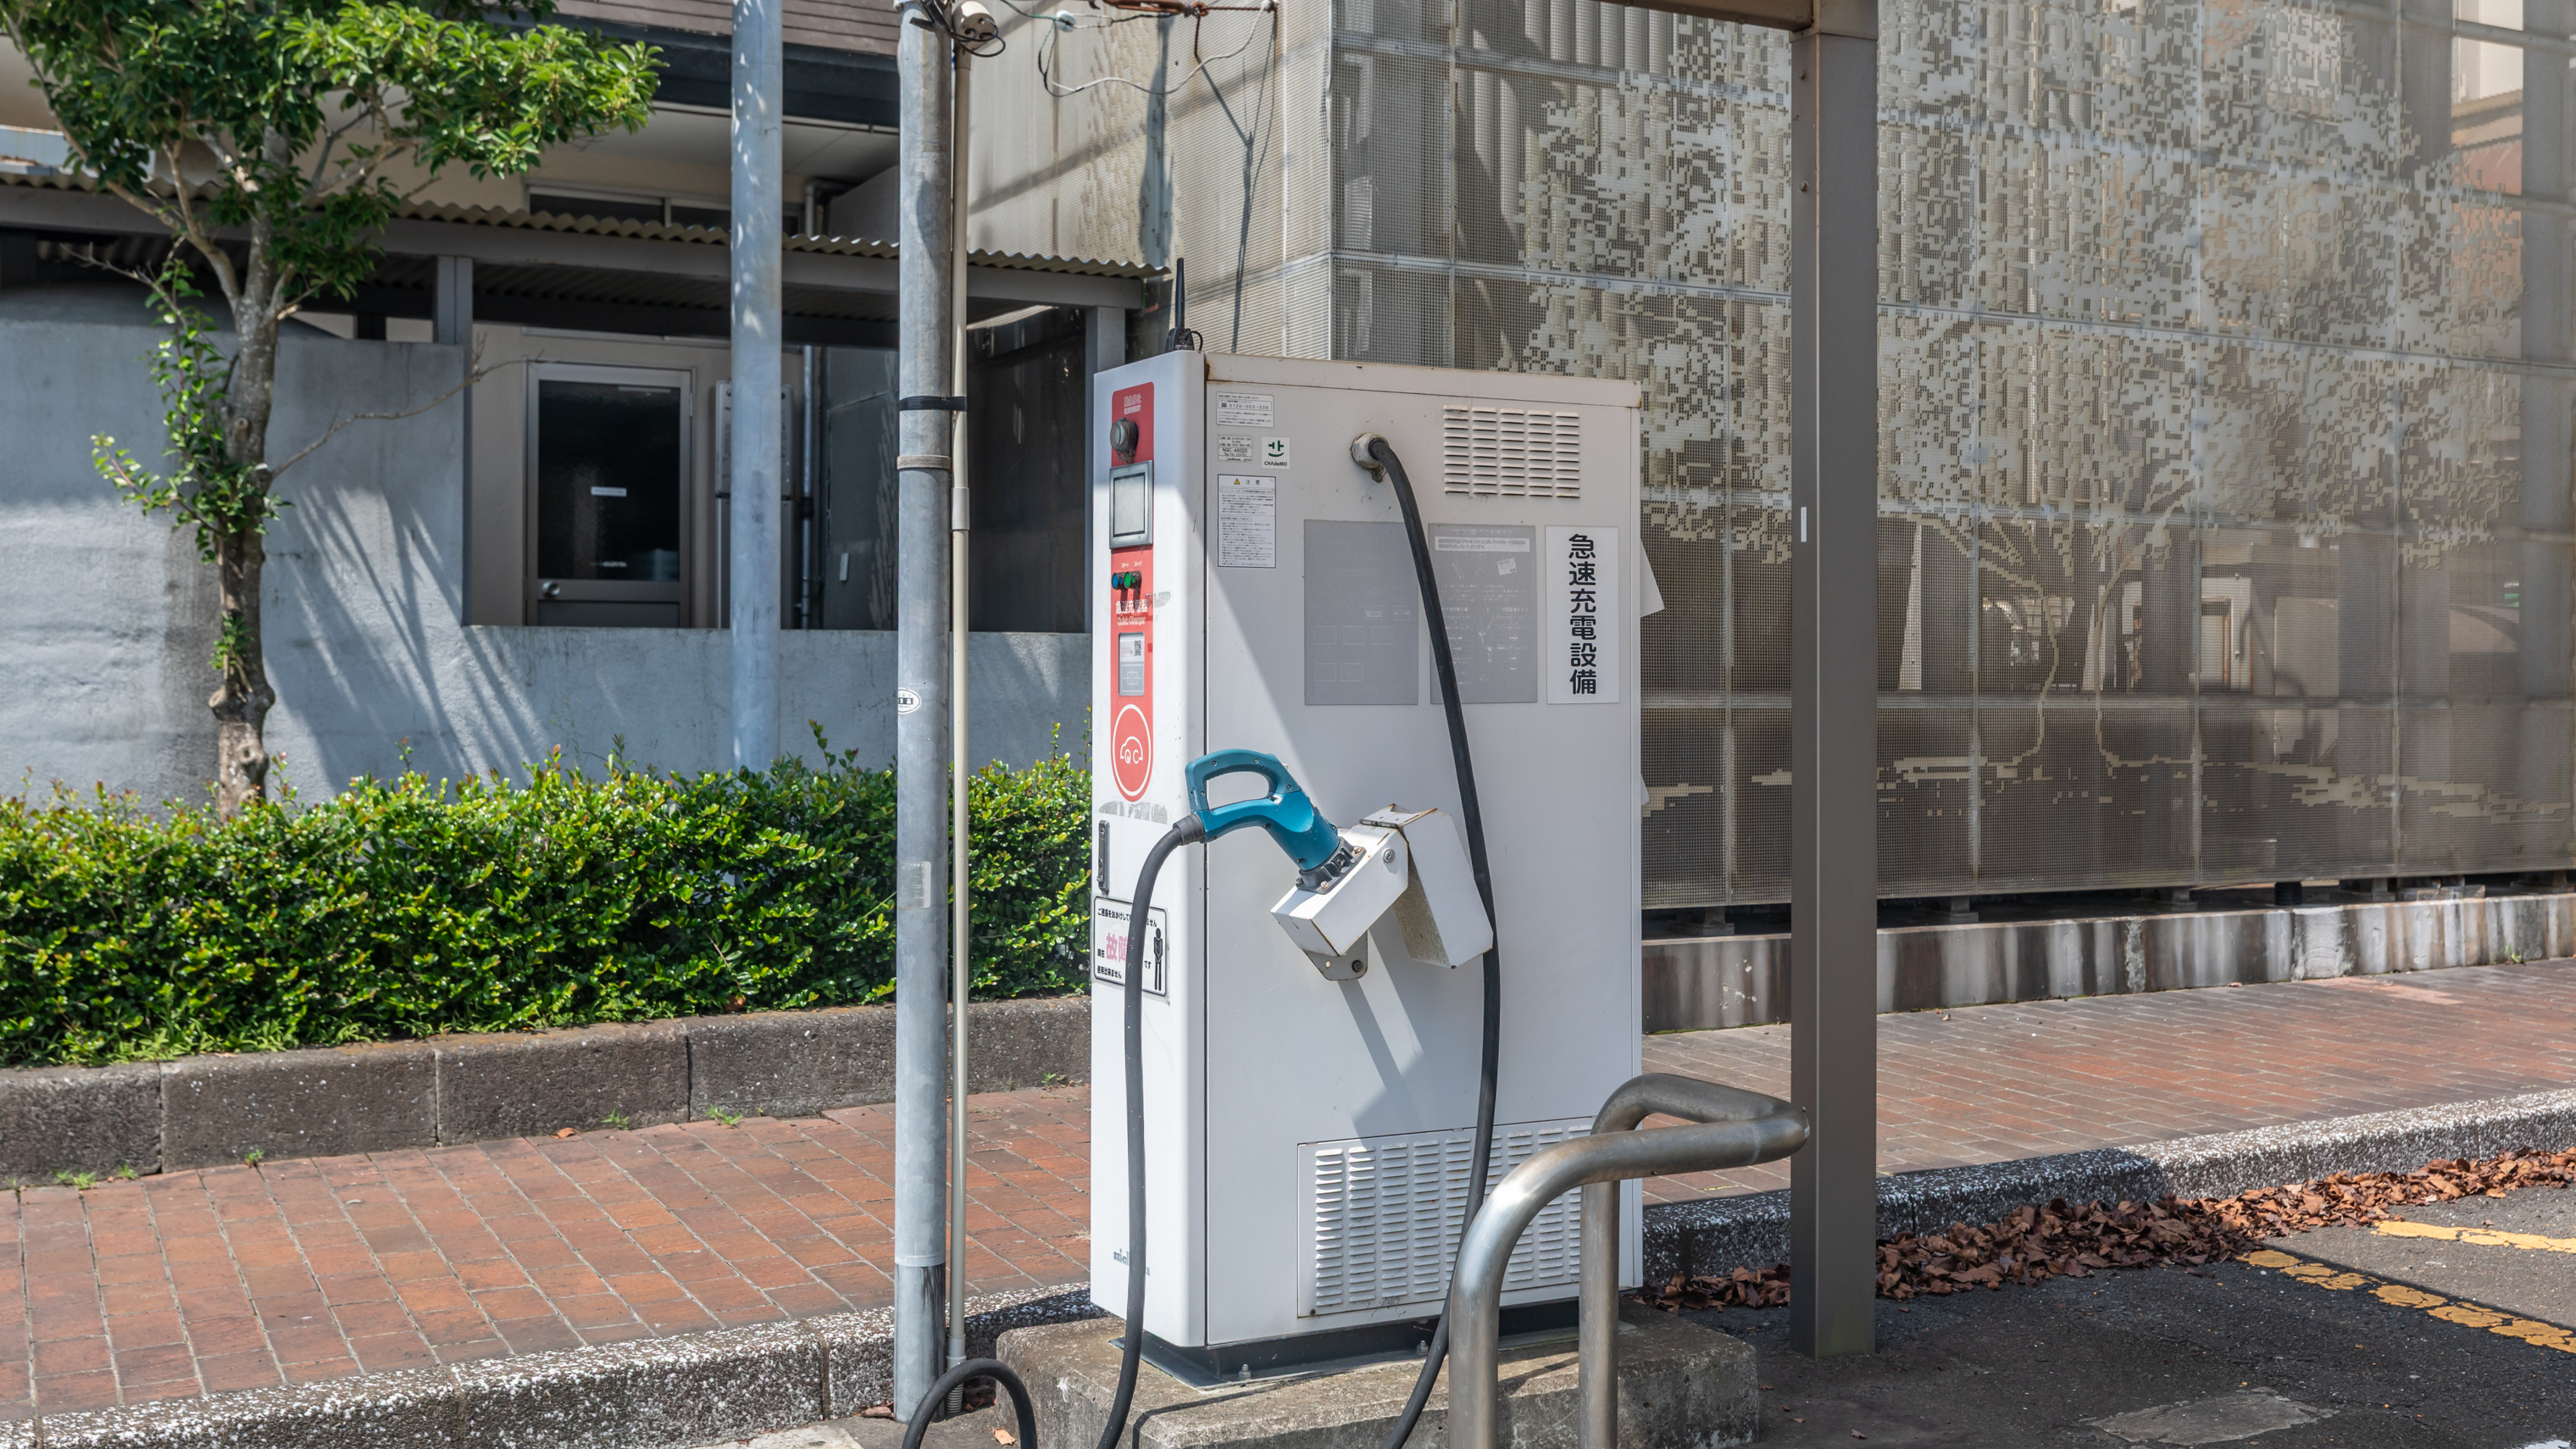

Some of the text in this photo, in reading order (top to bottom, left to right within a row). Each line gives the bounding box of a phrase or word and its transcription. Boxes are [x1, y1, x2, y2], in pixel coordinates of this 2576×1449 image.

[1568, 533, 1597, 695] 急速充電設備
[1144, 960, 1152, 969] です
[1097, 965, 1123, 980] 使用出来ません
